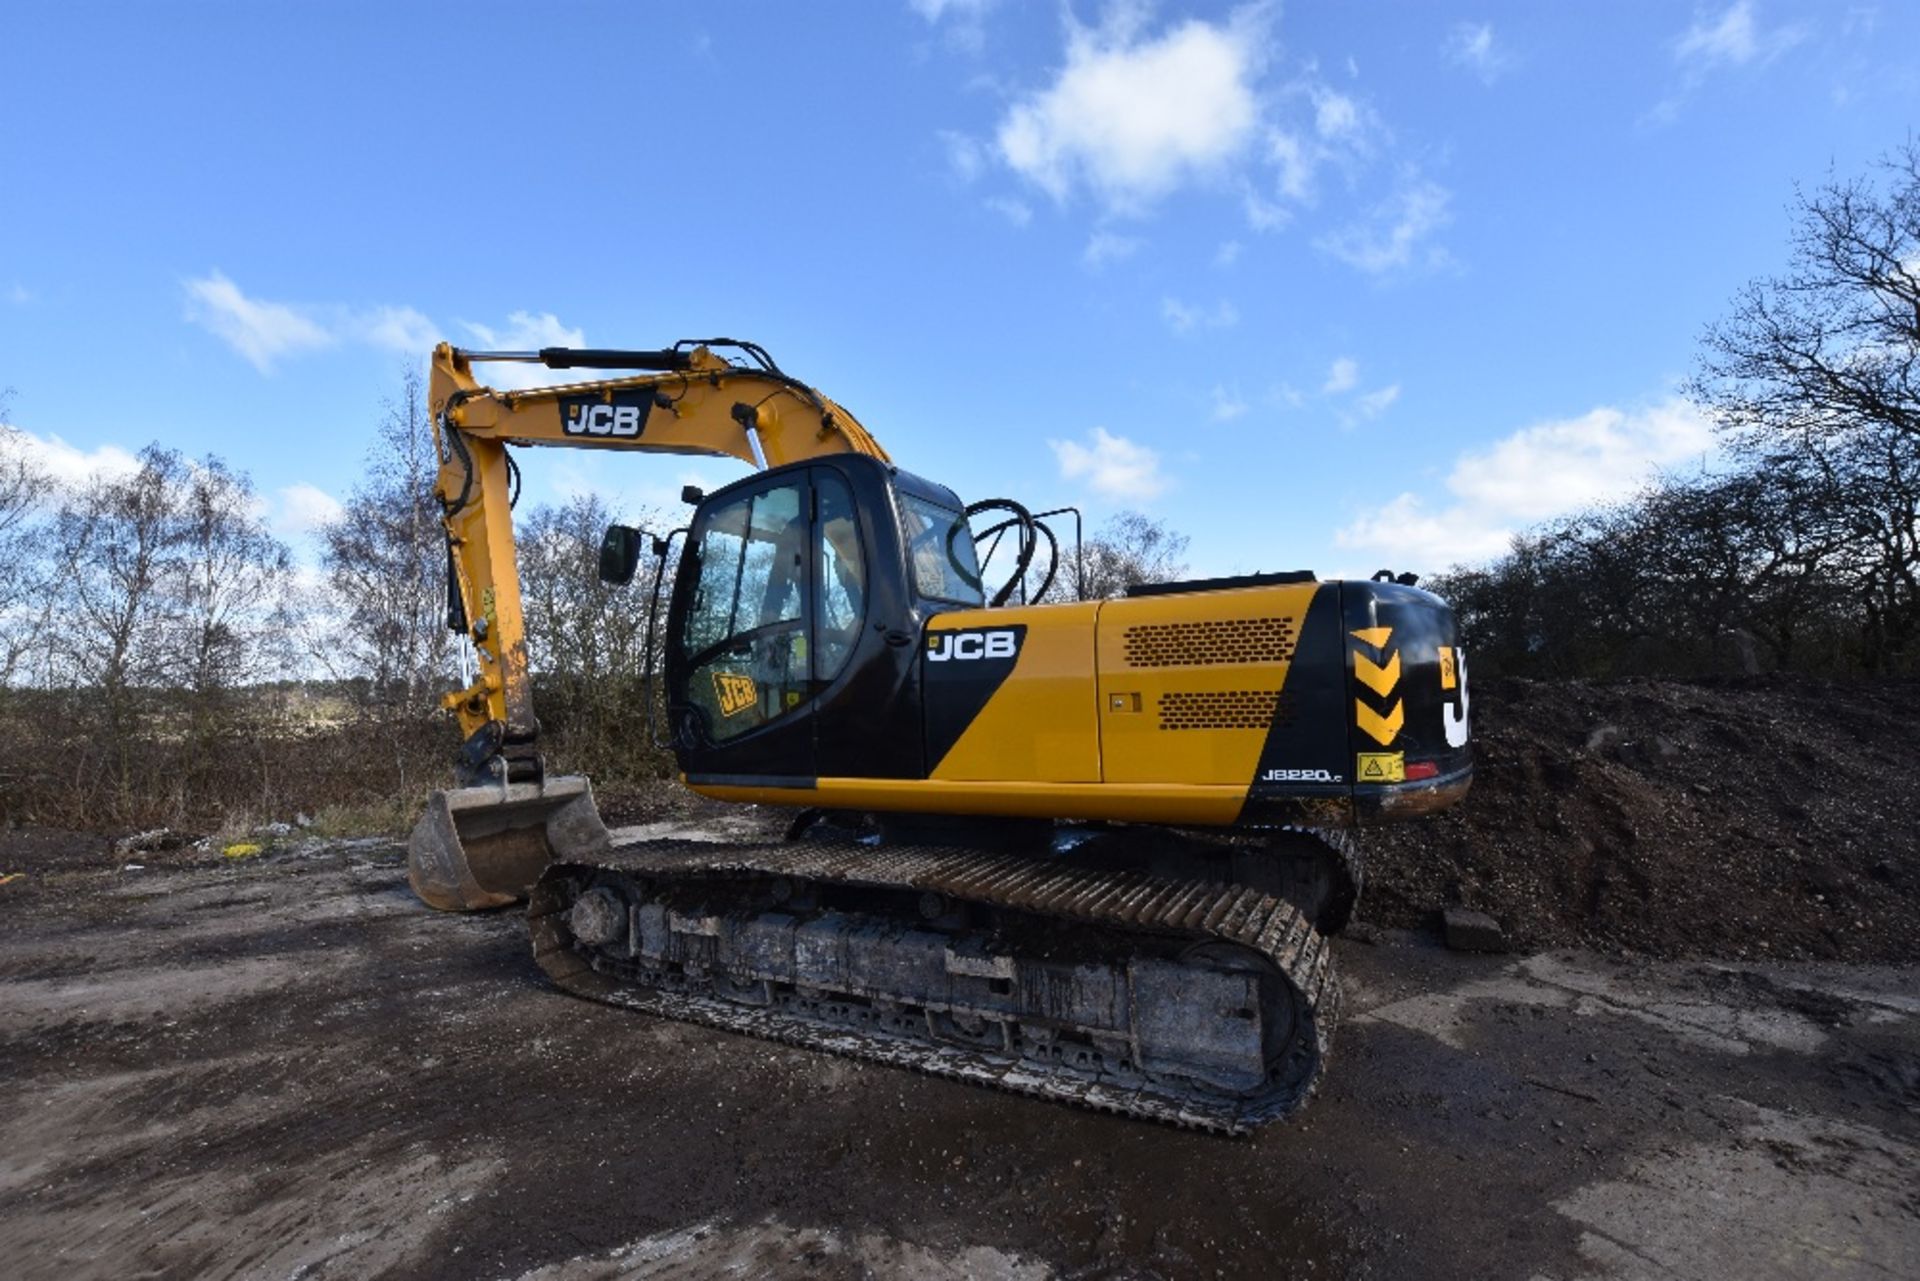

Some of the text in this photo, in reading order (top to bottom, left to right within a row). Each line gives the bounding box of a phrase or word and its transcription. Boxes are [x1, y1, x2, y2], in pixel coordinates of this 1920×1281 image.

[568, 404, 639, 435] JCB
[927, 631, 1016, 662] JCB
[720, 677, 755, 712] JCB
